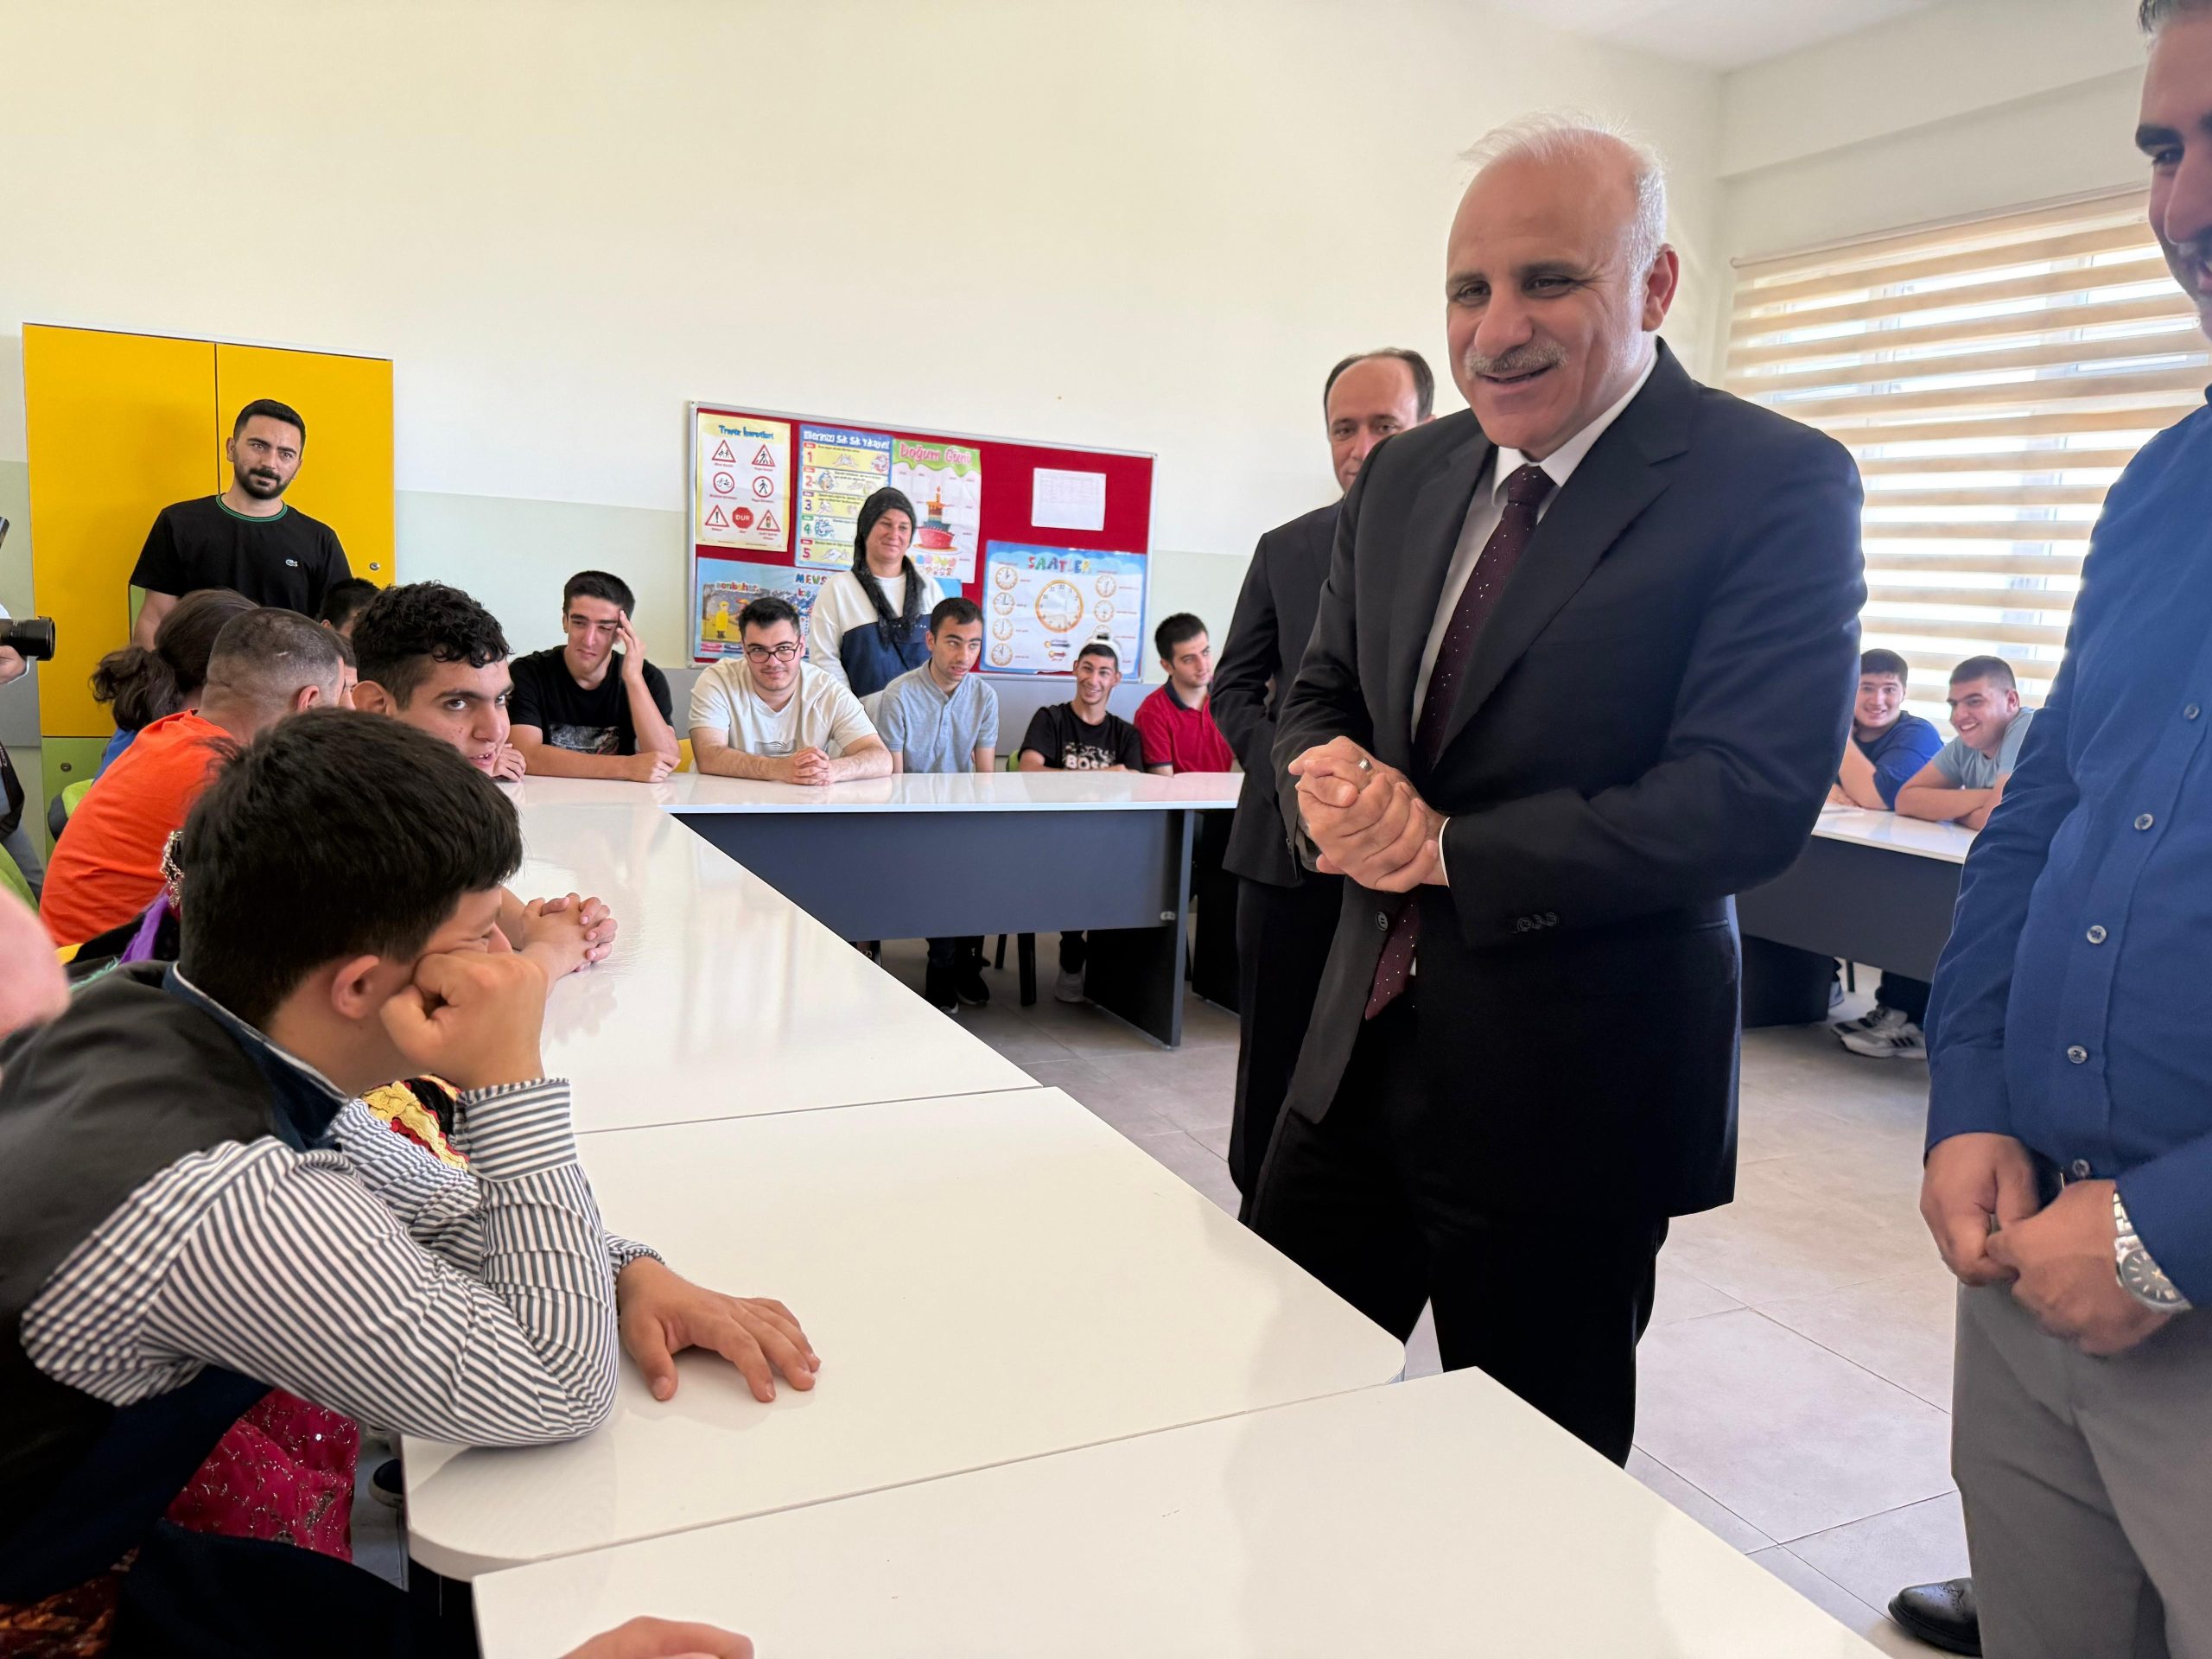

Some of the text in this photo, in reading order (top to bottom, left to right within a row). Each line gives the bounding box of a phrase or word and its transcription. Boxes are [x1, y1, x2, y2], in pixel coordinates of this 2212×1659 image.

[807, 451, 812, 462] 1
[900, 442, 971, 464] Doğum Günü
[805, 475, 813, 487] 2
[804, 499, 812, 511] 3
[804, 524, 810, 534] 4
[803, 548, 810, 558] 5
[1028, 556, 1091, 574] SAATLER
